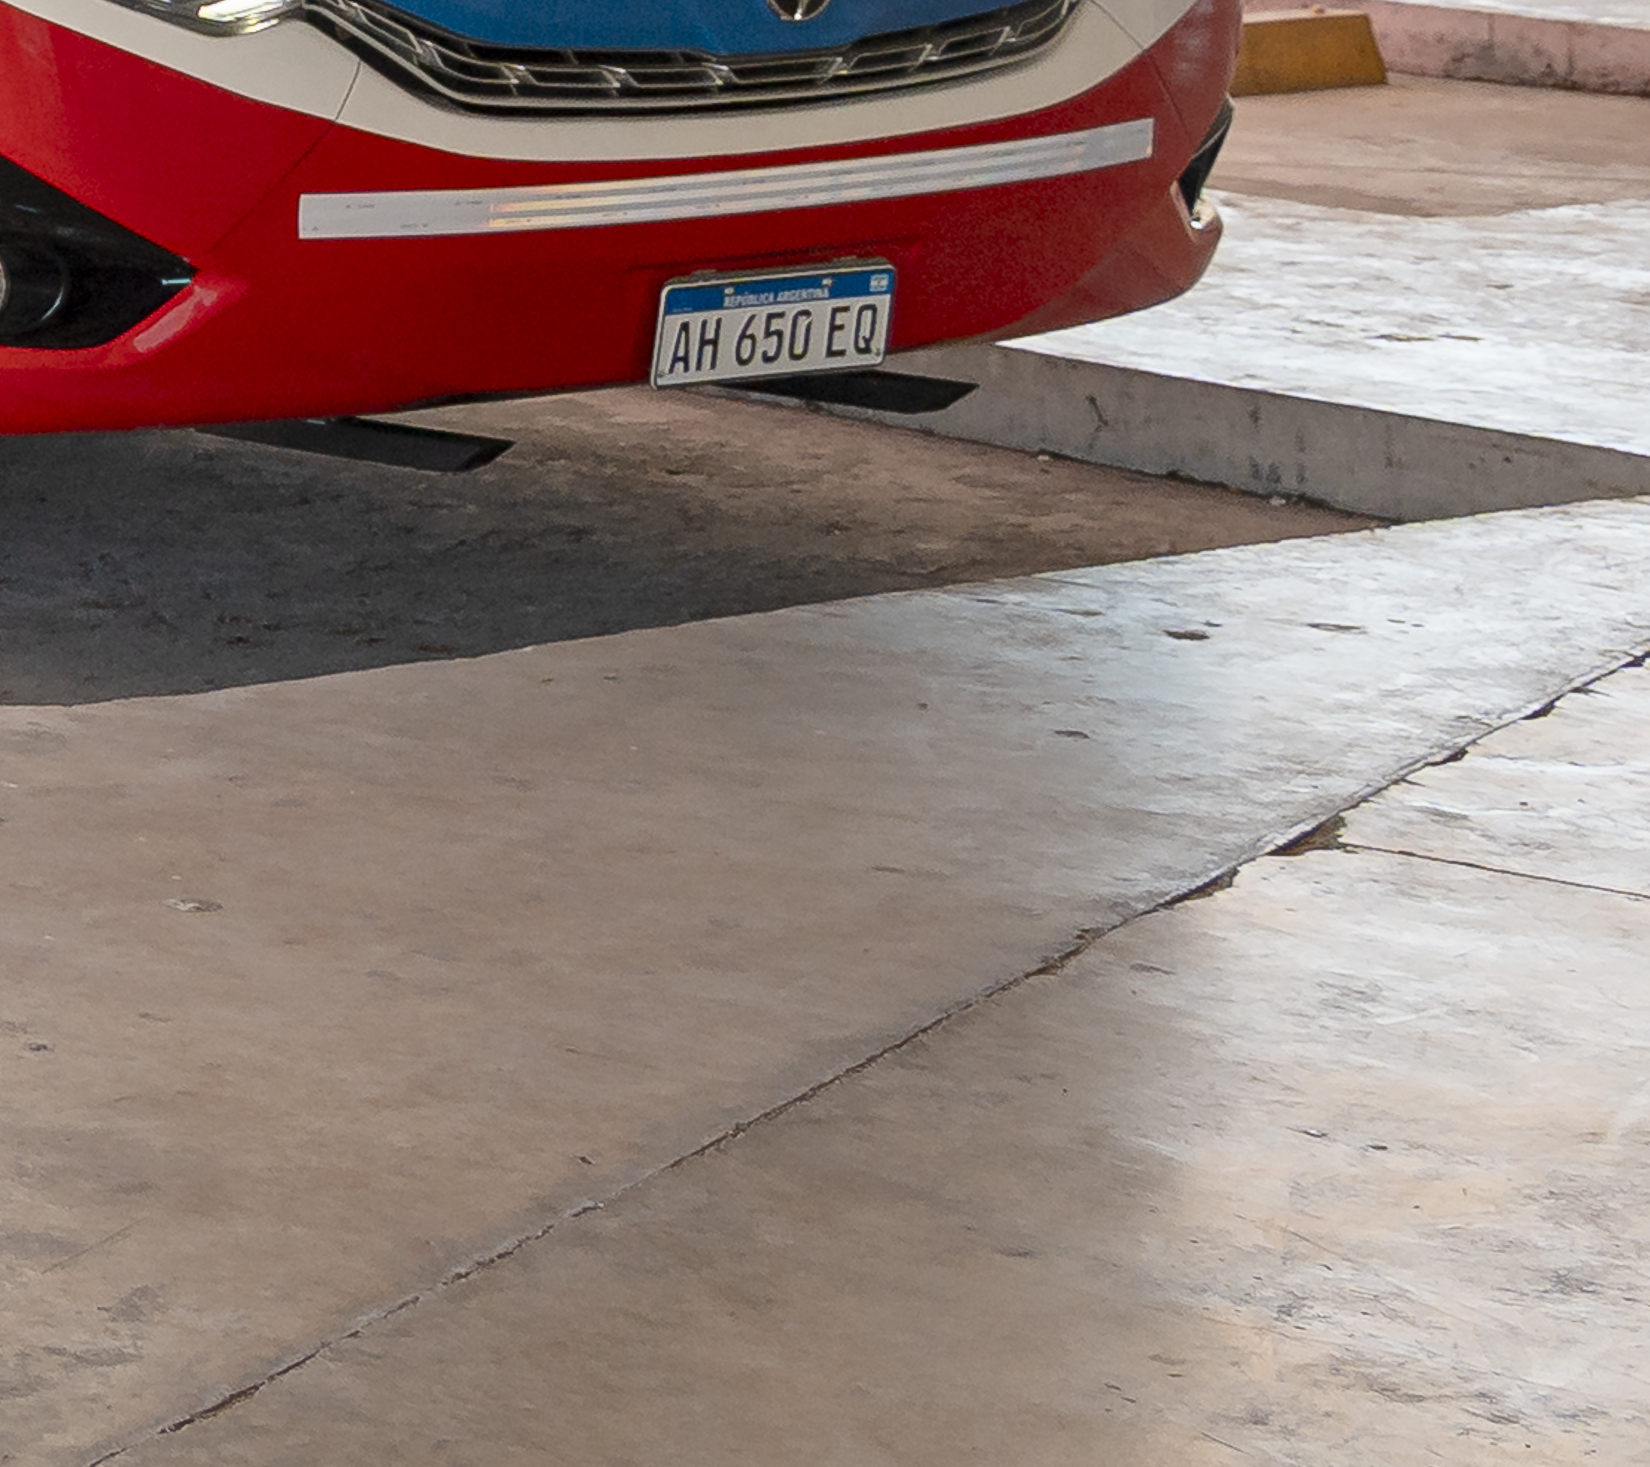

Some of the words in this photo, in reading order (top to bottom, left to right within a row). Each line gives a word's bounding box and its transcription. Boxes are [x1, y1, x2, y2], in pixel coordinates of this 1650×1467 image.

[668, 318, 722, 376] AH
[735, 308, 813, 367] 650
[825, 303, 879, 359] EQ
